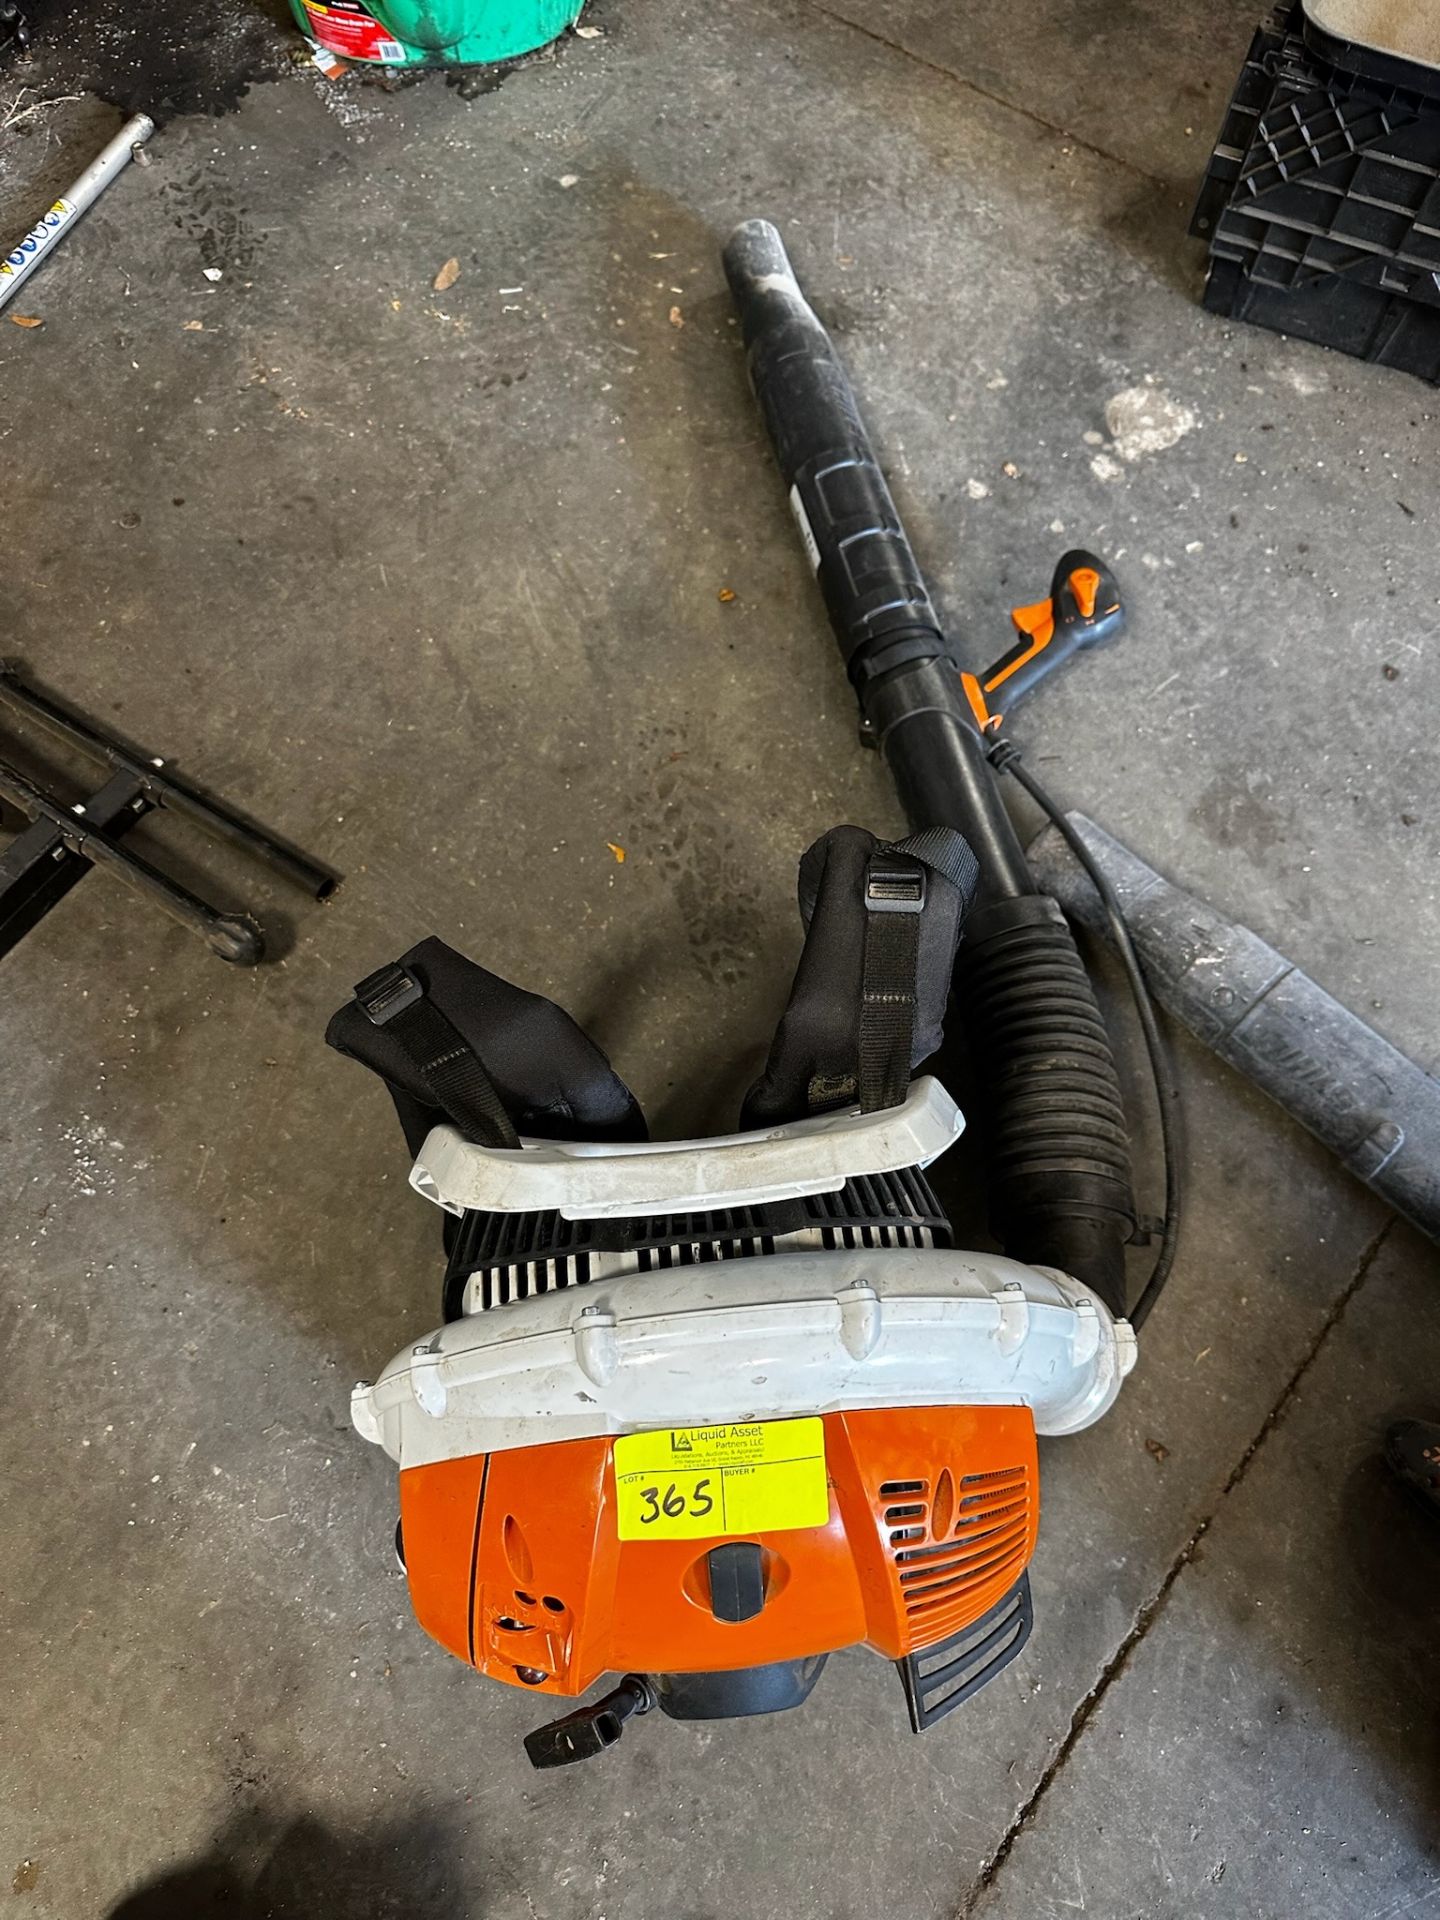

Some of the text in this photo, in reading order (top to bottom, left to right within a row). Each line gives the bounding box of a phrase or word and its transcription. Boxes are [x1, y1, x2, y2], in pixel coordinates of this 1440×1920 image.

[691, 1425, 763, 1442] Liquid Asset
[715, 1438, 764, 1449] Partners LLC
[724, 1468, 749, 1477] BUYER
[623, 1476, 638, 1484] LOT
[639, 1478, 713, 1524] 365
